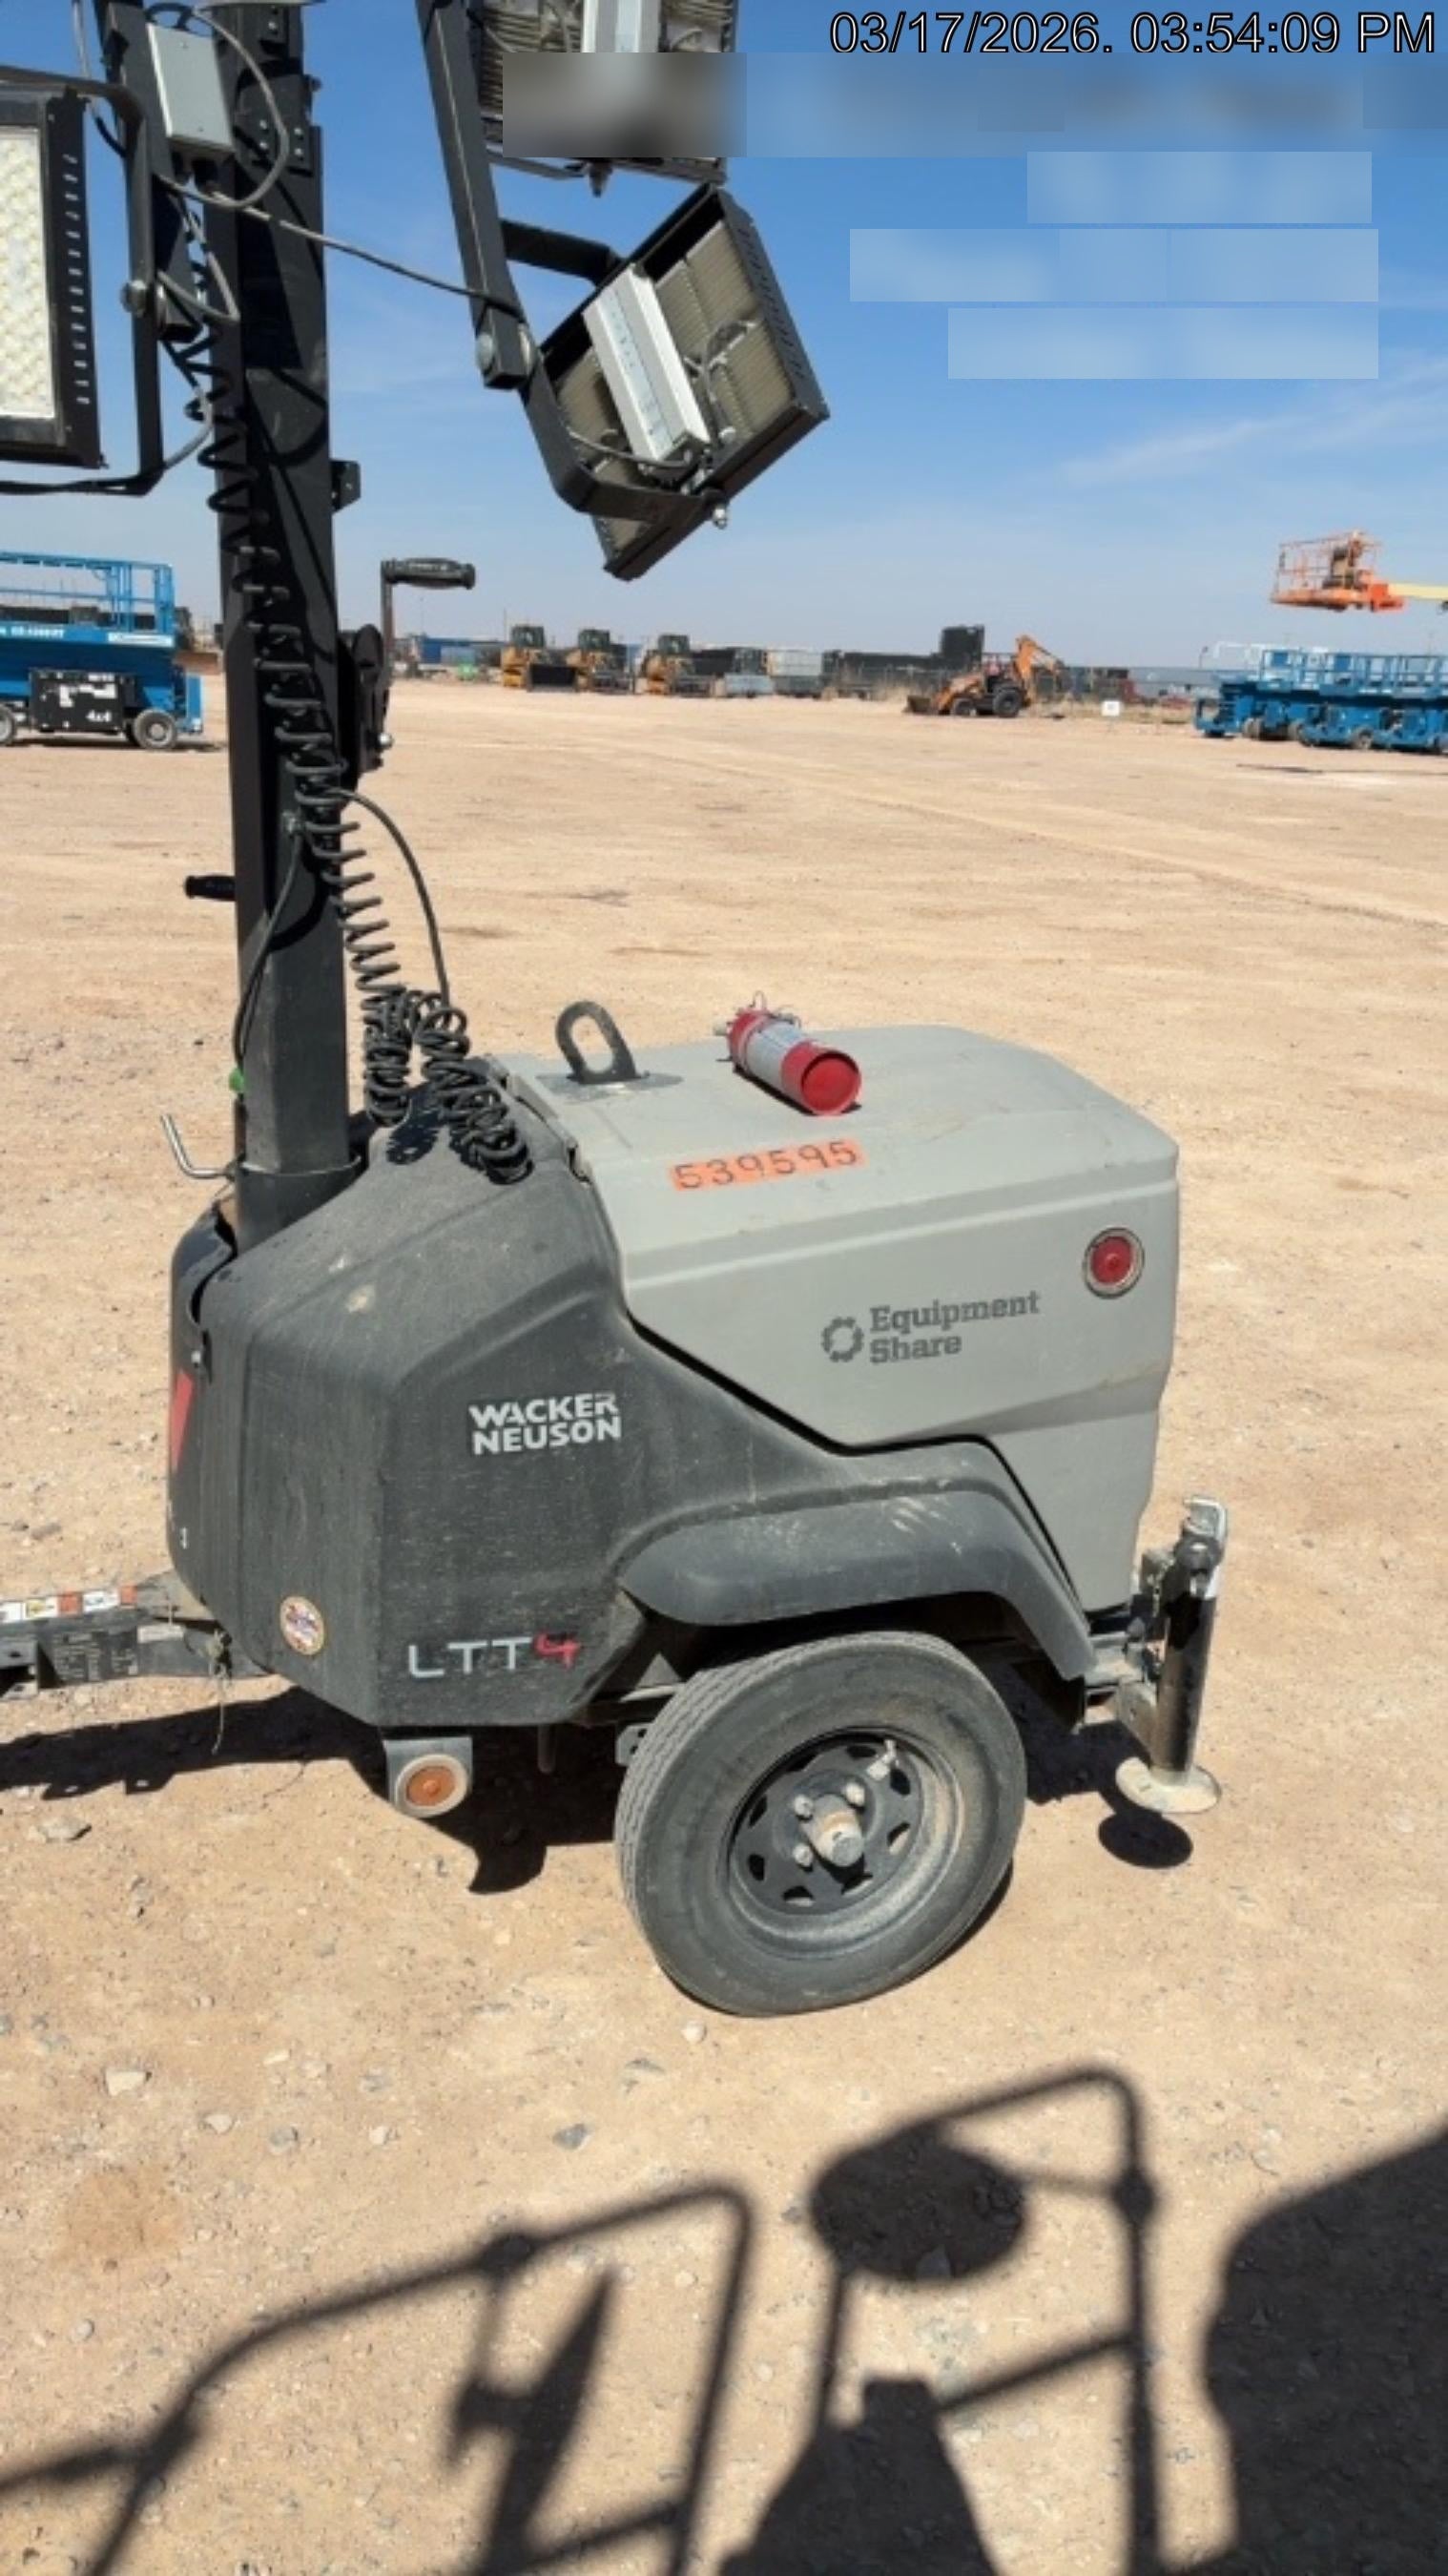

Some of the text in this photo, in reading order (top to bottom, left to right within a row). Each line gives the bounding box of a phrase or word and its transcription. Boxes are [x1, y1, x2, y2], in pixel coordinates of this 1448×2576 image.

[673, 1140, 858, 1189] 539595
[869, 1290, 1041, 1335] Equipment
[869, 1335, 962, 1363] Share
[468, 1392, 619, 1429] WACKER
[473, 1415, 622, 1455] NEUSON
